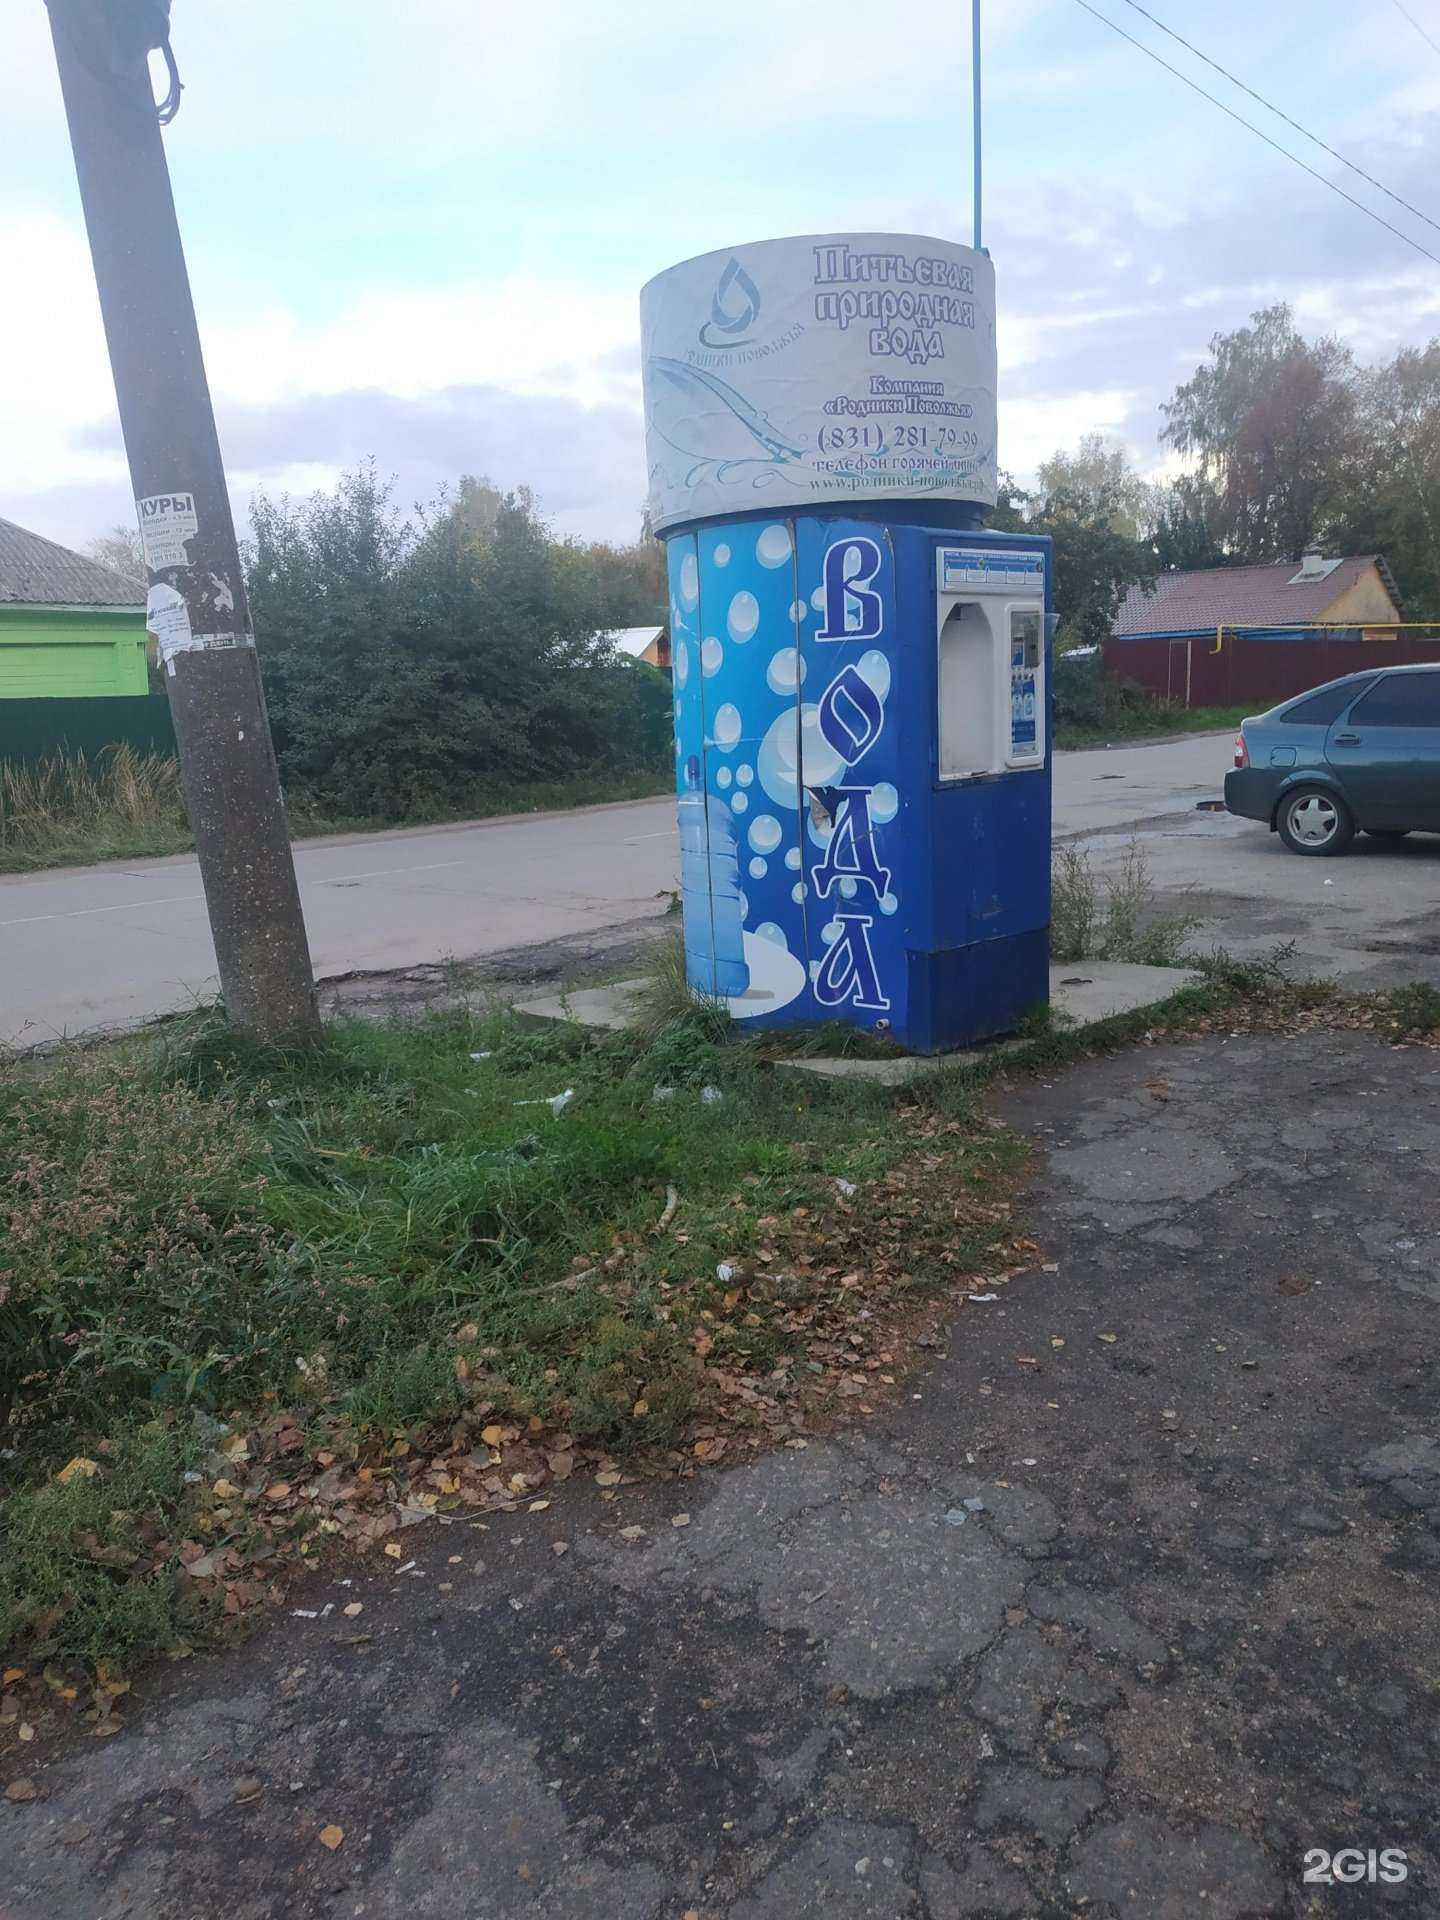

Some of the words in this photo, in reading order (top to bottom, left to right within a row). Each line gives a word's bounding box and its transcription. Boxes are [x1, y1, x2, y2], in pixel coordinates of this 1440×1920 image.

[813, 244, 974, 294] Питьевая
[869, 375, 945, 396] Компания
[823, 395, 904, 418] «Родники
[817, 424, 884, 454] (831)
[140, 495, 193, 519] КУРЫ
